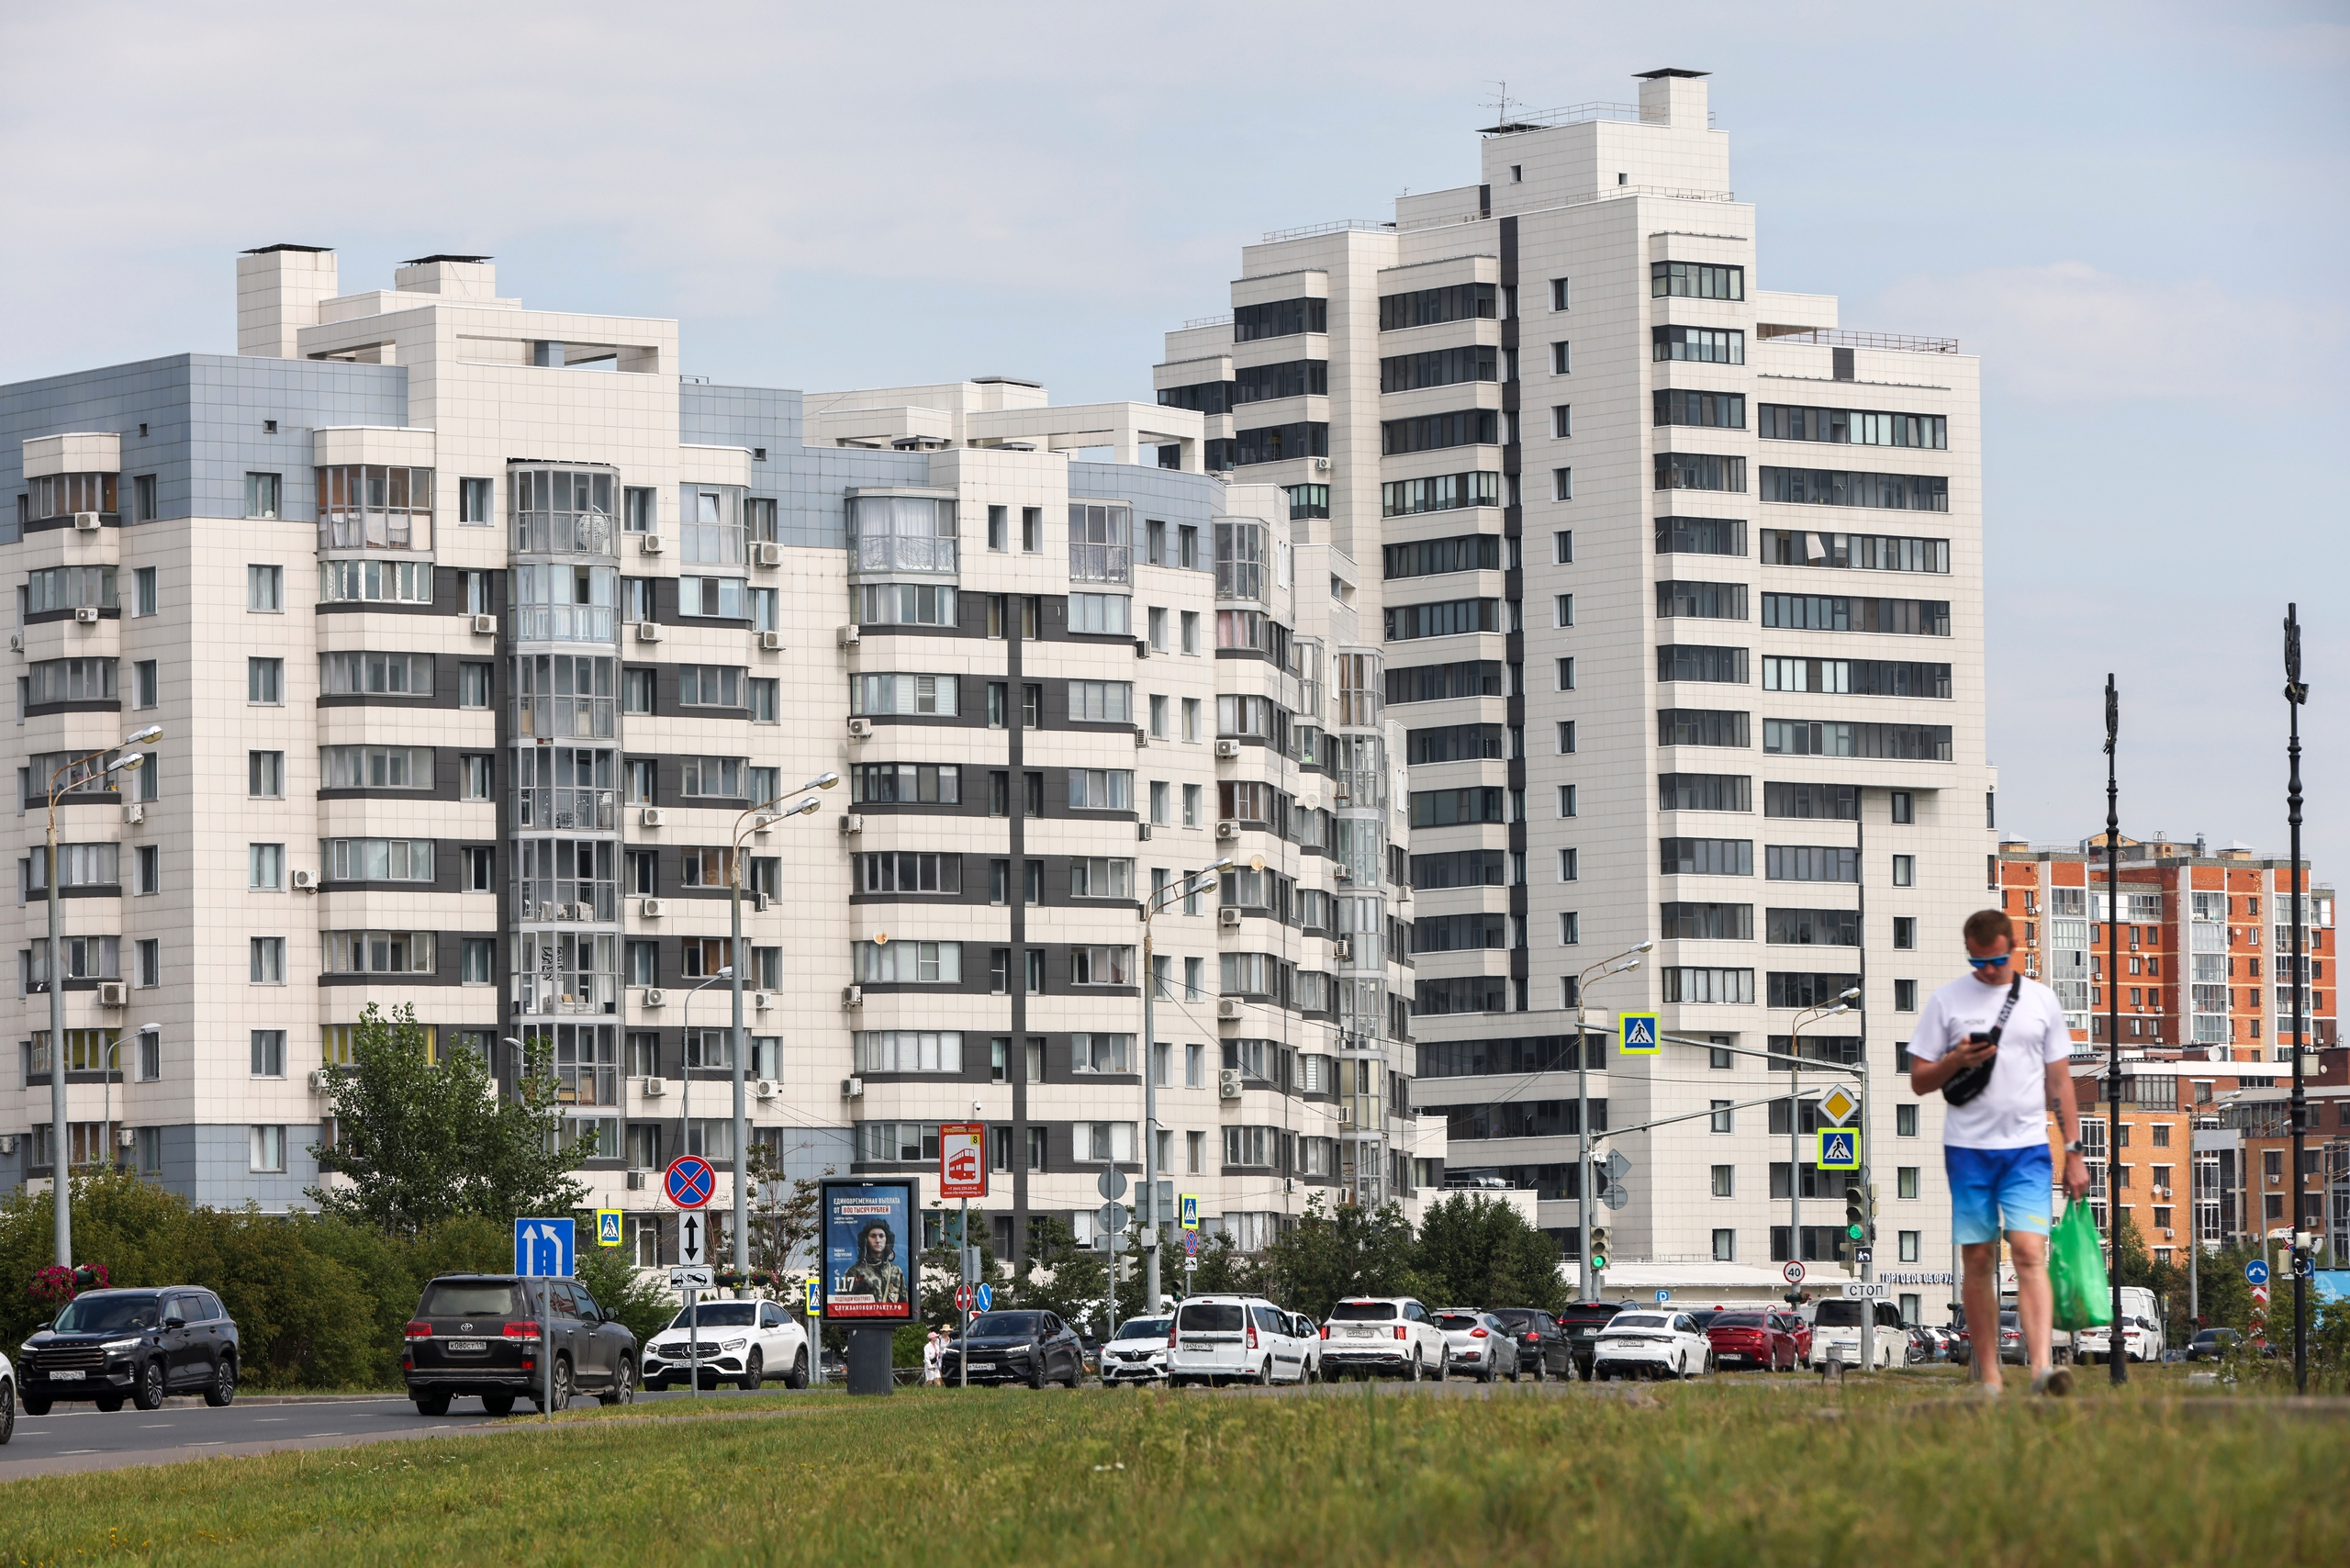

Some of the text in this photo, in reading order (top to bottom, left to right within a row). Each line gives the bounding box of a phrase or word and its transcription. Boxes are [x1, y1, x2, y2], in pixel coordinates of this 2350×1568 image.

[973, 1136, 978, 1144] 8
[1788, 1268, 1800, 1277] 40
[1881, 1273, 1920, 1284] ТОРГОВОЕ
[834, 1277, 855, 1292] 117
[1850, 1285, 1883, 1296] СТОП
